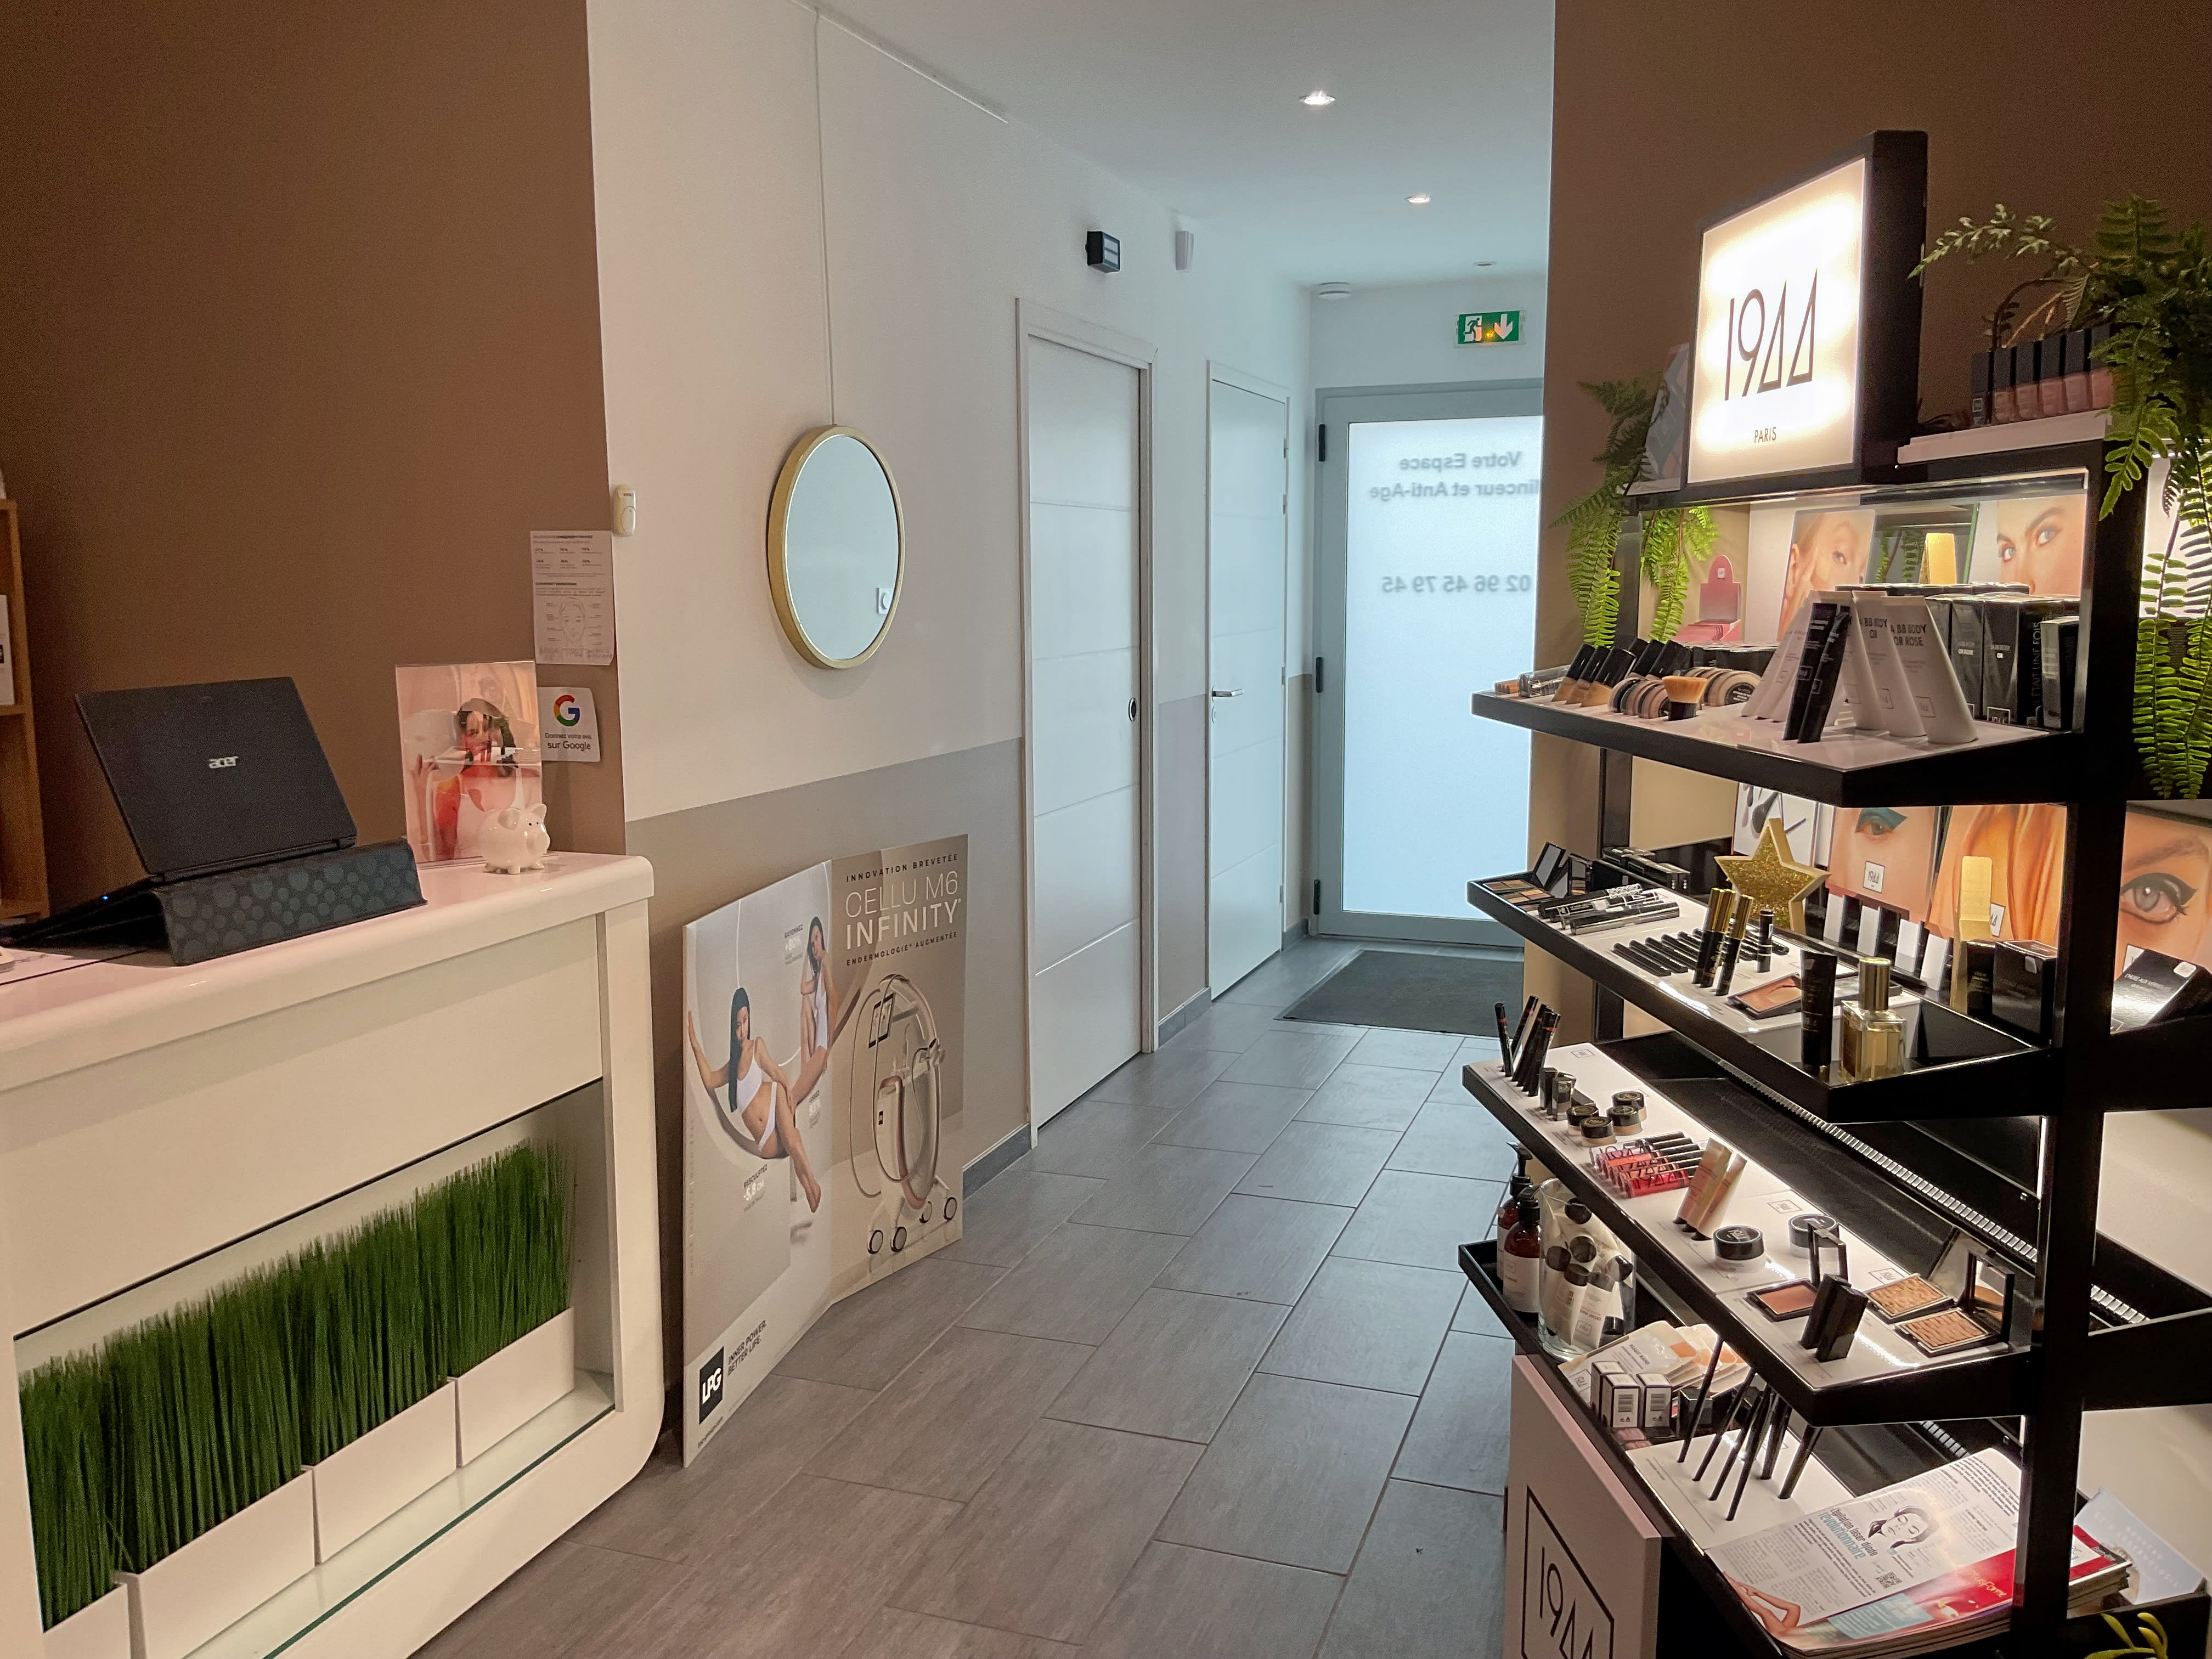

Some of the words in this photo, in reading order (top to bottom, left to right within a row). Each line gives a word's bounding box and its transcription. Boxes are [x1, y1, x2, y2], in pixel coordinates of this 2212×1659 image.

[1724, 268, 1818, 400] 1944
[1754, 426, 1777, 443] PARIS
[563, 741, 591, 751] Google
[208, 756, 239, 768] acer
[847, 864, 907, 882] INNOVATION
[1867, 870, 1880, 884] 1944
[845, 879, 916, 918] CELLU
[926, 871, 957, 900] M6
[728, 1341, 745, 1365] INNER
[728, 1350, 748, 1376] BETTER
[702, 1368, 722, 1404] LPG
[1849, 1527, 1866, 1542] laser
[1860, 1542, 1878, 1556] diode
